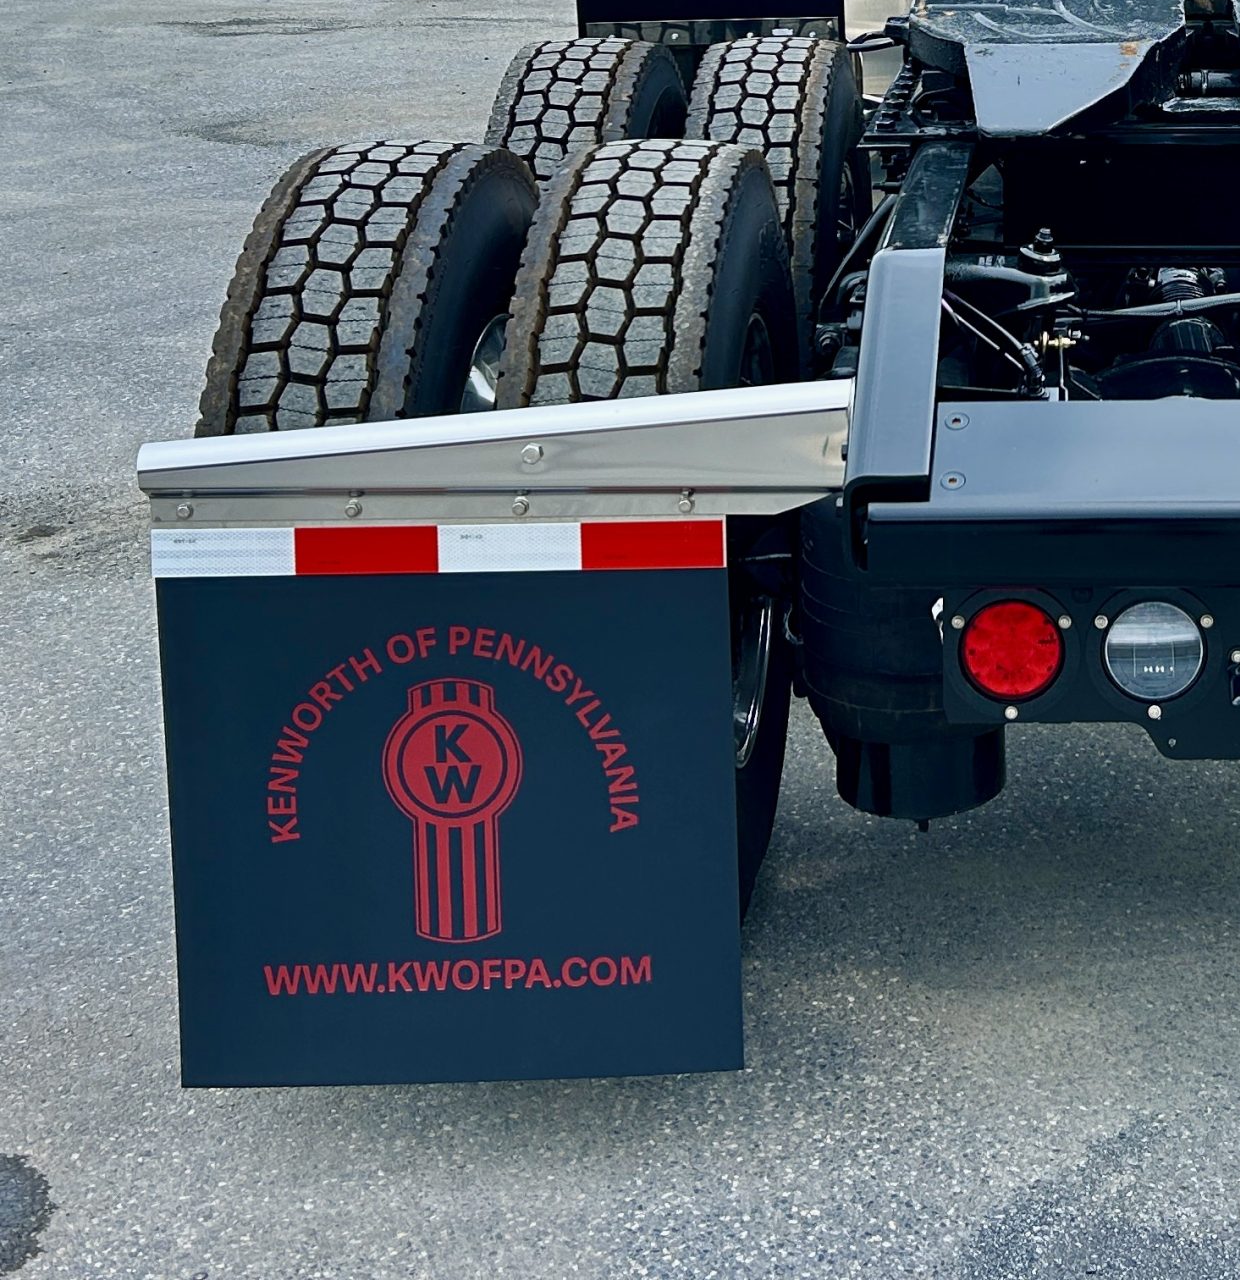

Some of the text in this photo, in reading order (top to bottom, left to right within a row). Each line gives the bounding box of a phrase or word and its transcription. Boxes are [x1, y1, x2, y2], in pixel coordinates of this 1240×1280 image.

[267, 626, 638, 842] KENWORTH OF PENNSYLVANIA
[264, 956, 652, 996] WWW.KWOFPA.COM
